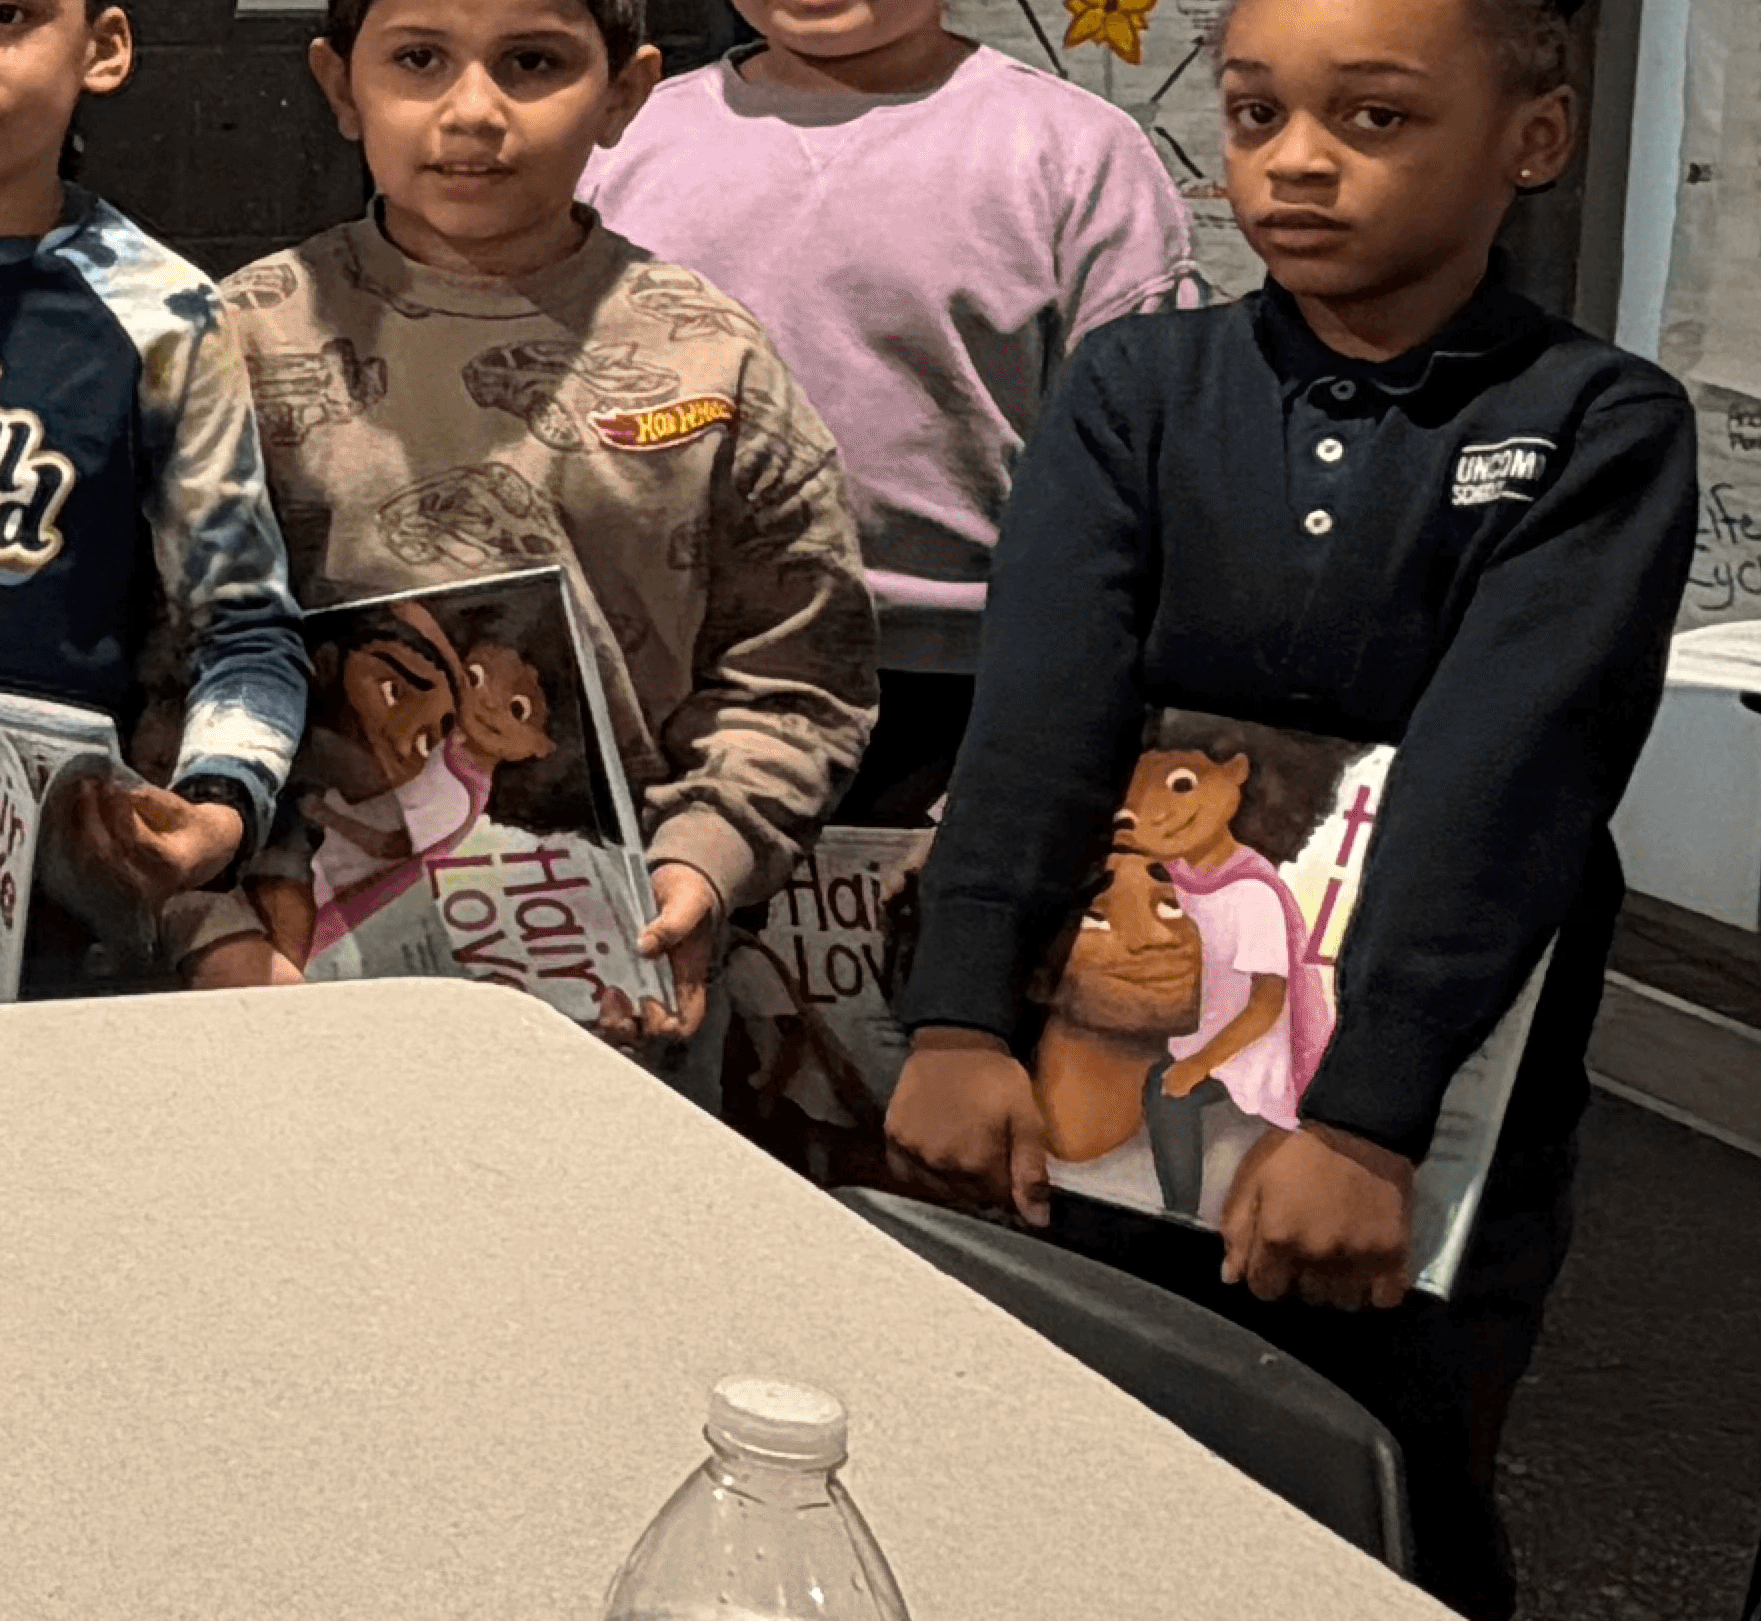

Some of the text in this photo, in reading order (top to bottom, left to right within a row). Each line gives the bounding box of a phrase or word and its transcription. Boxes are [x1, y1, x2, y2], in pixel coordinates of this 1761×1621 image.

[1456, 448, 1547, 482] UNCOM
[1695, 482, 1761, 545] ife
[500, 844, 610, 1004] Hair
[784, 852, 881, 932] Hai
[793, 934, 894, 1006] Lov
